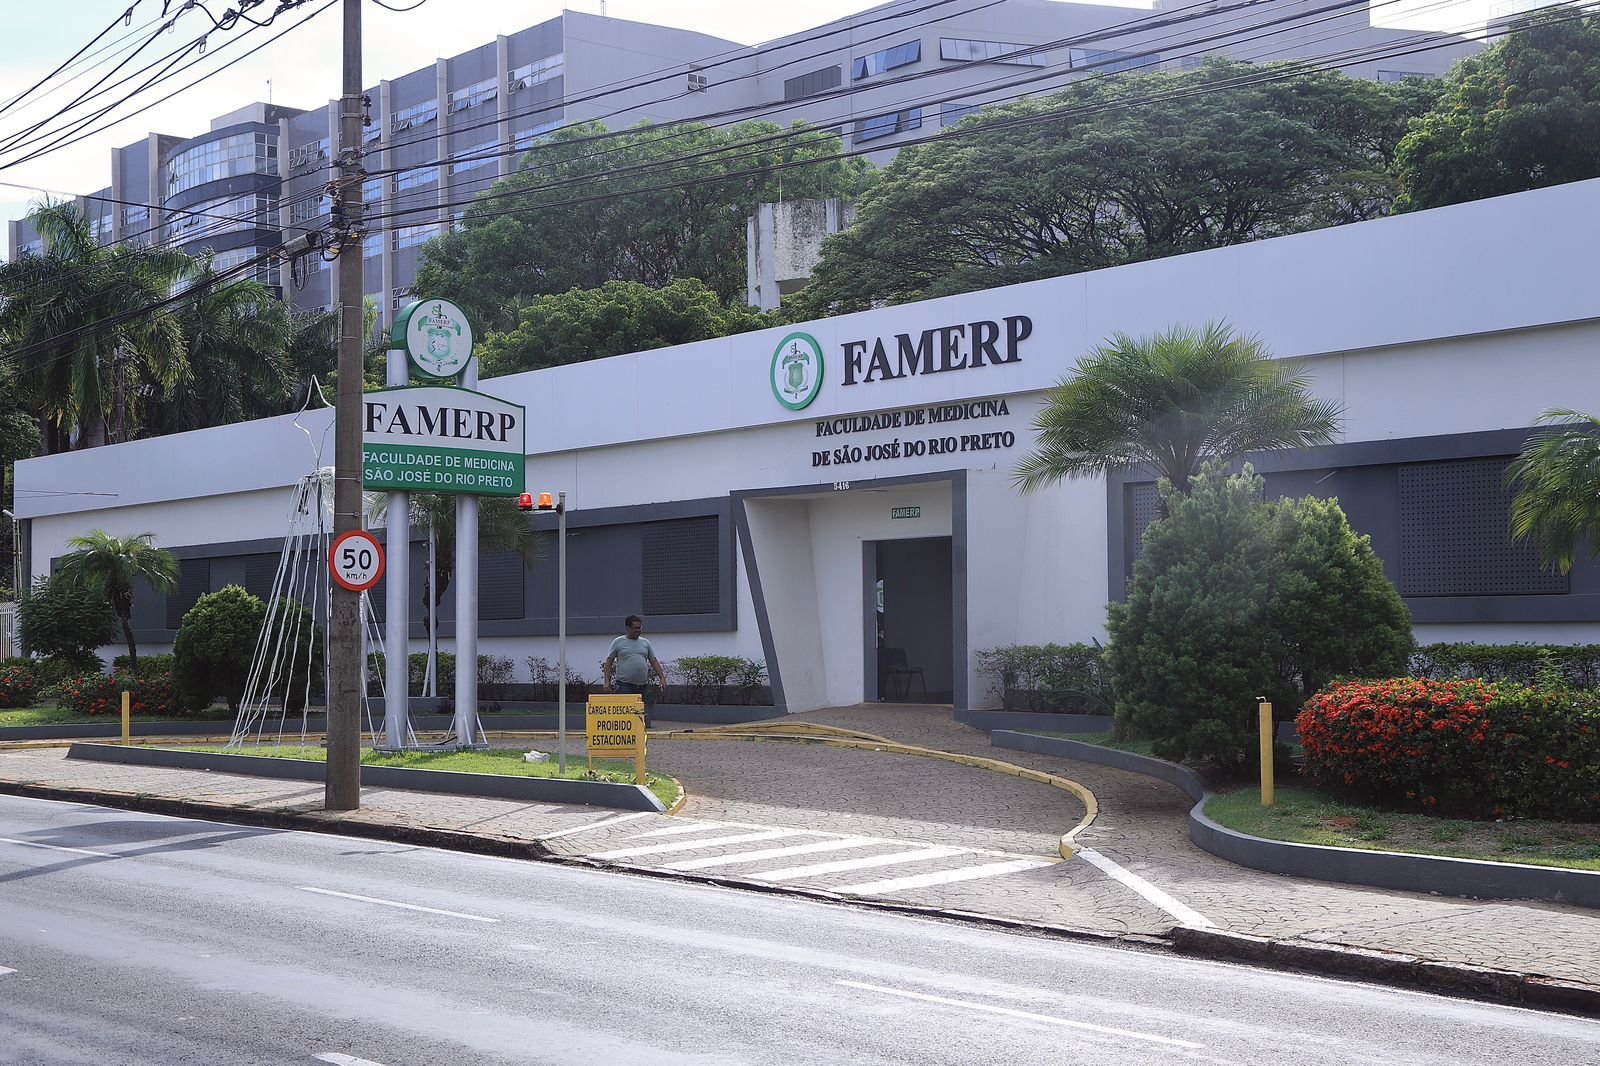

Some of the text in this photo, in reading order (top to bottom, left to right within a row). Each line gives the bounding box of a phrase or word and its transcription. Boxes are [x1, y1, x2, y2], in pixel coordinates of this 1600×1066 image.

[840, 315, 1033, 386] FAMERP
[363, 402, 516, 442] FAMERP
[815, 399, 1010, 437] FACULDADE DE MEDICINA
[812, 431, 1015, 467] DE SÃO JOSÉ DO RIO PRETO
[362, 451, 515, 472] FACULDADE DE MEDICINA
[365, 466, 513, 488] SÃO JOSÉ DO RIO PRETO
[833, 482, 850, 490] 5416
[892, 508, 920, 518] FAMERP
[343, 549, 371, 569] 50
[346, 572, 368, 580] km/h
[588, 705, 607, 715] CARGA
[608, 706, 612, 715] E
[597, 720, 632, 730] PROIBIDO
[592, 735, 636, 745] ESTACIONAR
